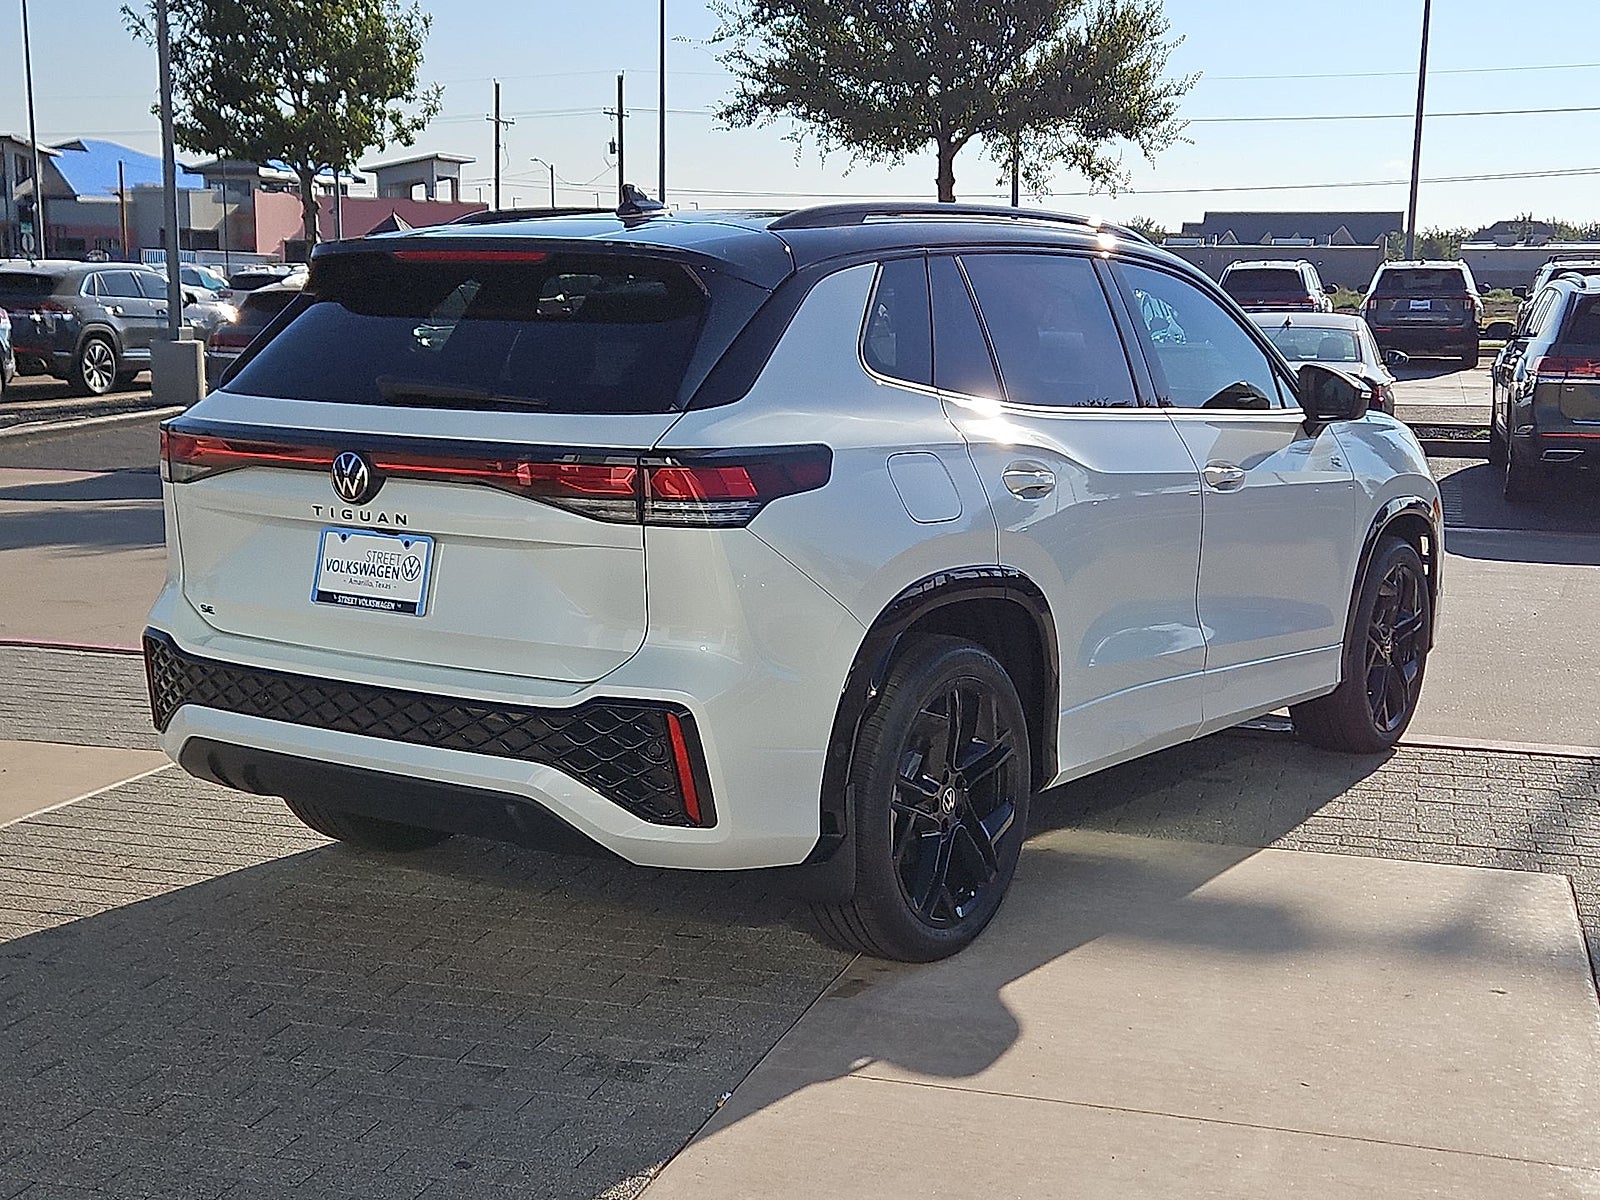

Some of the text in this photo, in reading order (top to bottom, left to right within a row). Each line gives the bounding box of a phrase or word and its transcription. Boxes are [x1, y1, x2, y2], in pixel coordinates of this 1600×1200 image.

[312, 505, 407, 525] TIGUAN
[366, 550, 402, 566] STREET
[326, 558, 400, 580] VOLKSWAGEN
[375, 581, 391, 589] Texas
[200, 604, 215, 615] SE
[337, 595, 396, 609] STREET VOLKSWAGEN
